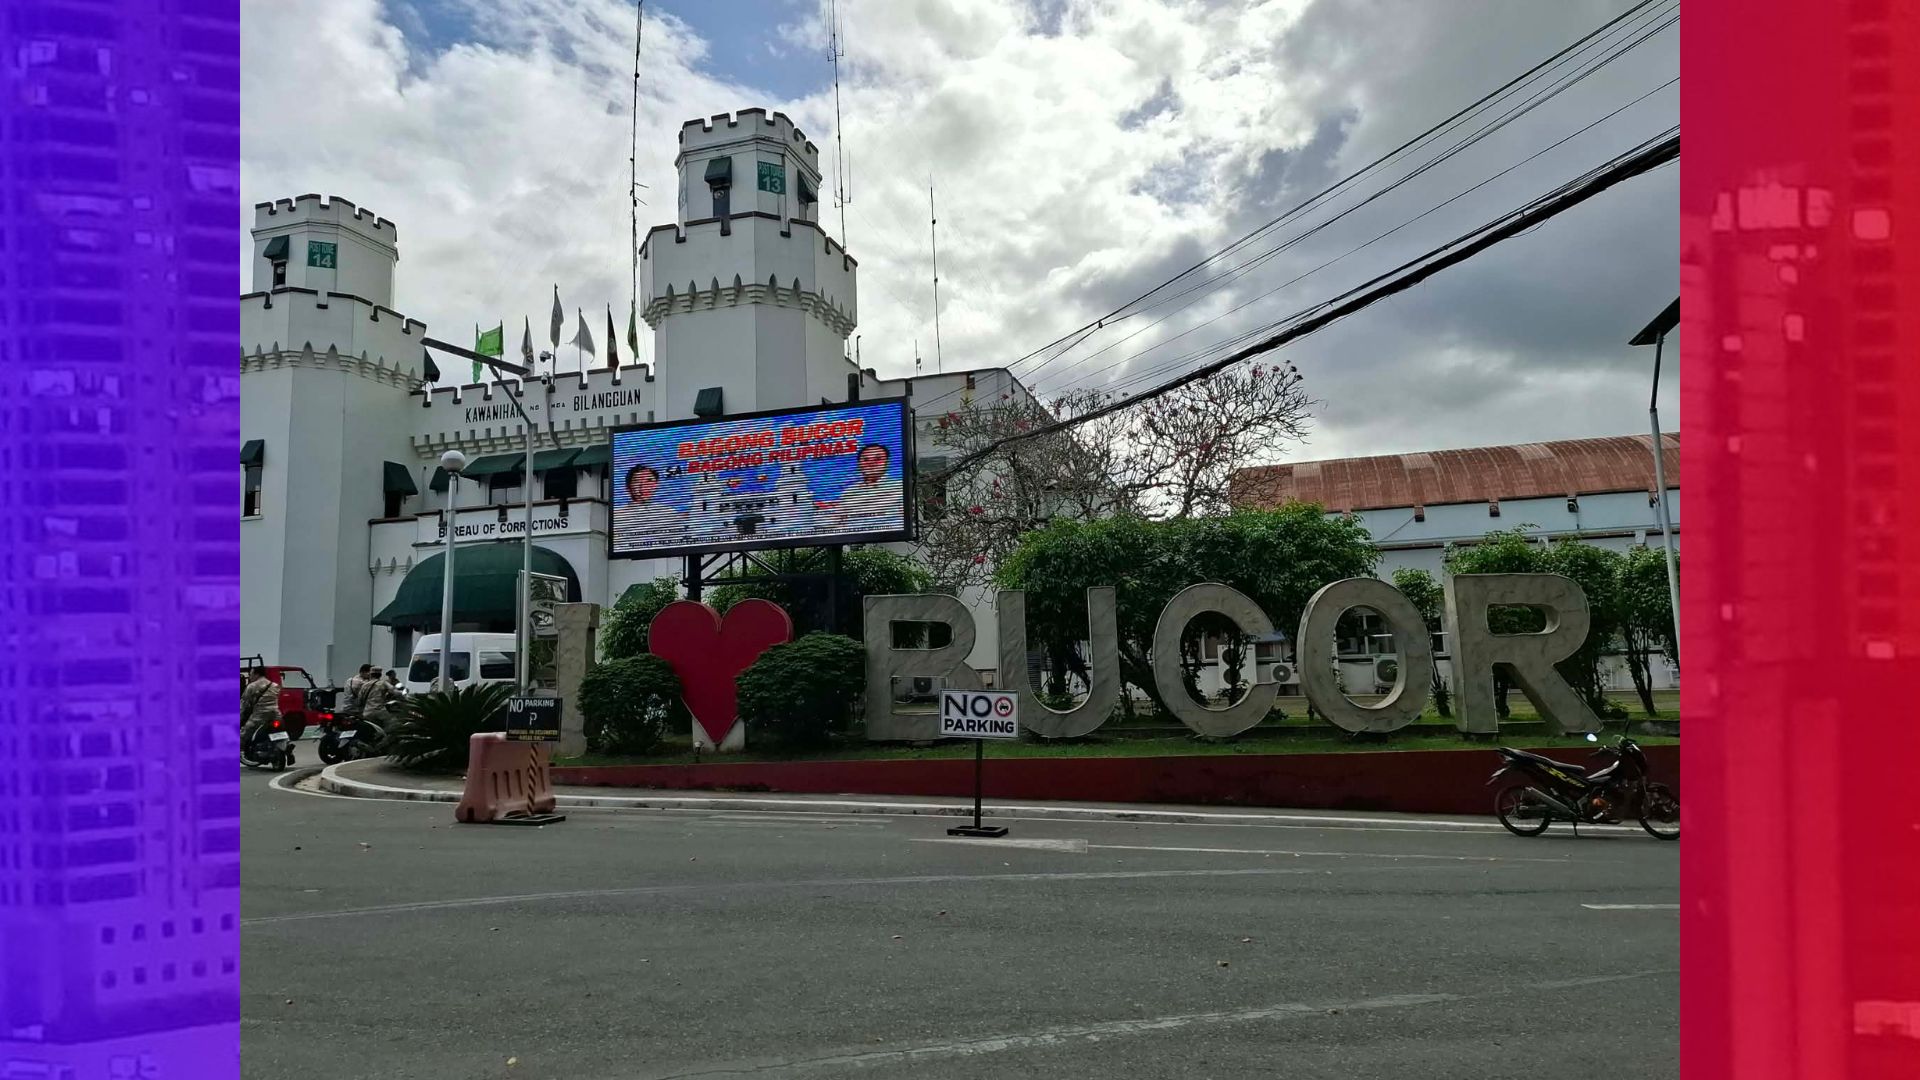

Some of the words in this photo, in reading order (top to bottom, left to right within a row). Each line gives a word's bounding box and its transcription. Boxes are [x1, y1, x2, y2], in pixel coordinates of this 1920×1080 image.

[763, 176, 781, 192] 13
[313, 254, 332, 268] 14
[465, 402, 523, 423] KAWANIHAN
[573, 388, 641, 411] BILANGGUAN
[678, 429, 774, 458] BAGONG
[781, 418, 865, 445] BUCOR
[665, 464, 682, 478] SA
[768, 438, 858, 463] PILIPINAS
[438, 525, 479, 538] BREAU
[482, 523, 496, 534] OF
[500, 517, 569, 533] CORRCTIONS
[863, 572, 1604, 742] BUCOR
[509, 699, 524, 713] NO
[524, 699, 555, 708] PARKING
[944, 694, 993, 718] NO
[943, 718, 1015, 733] PARKING
